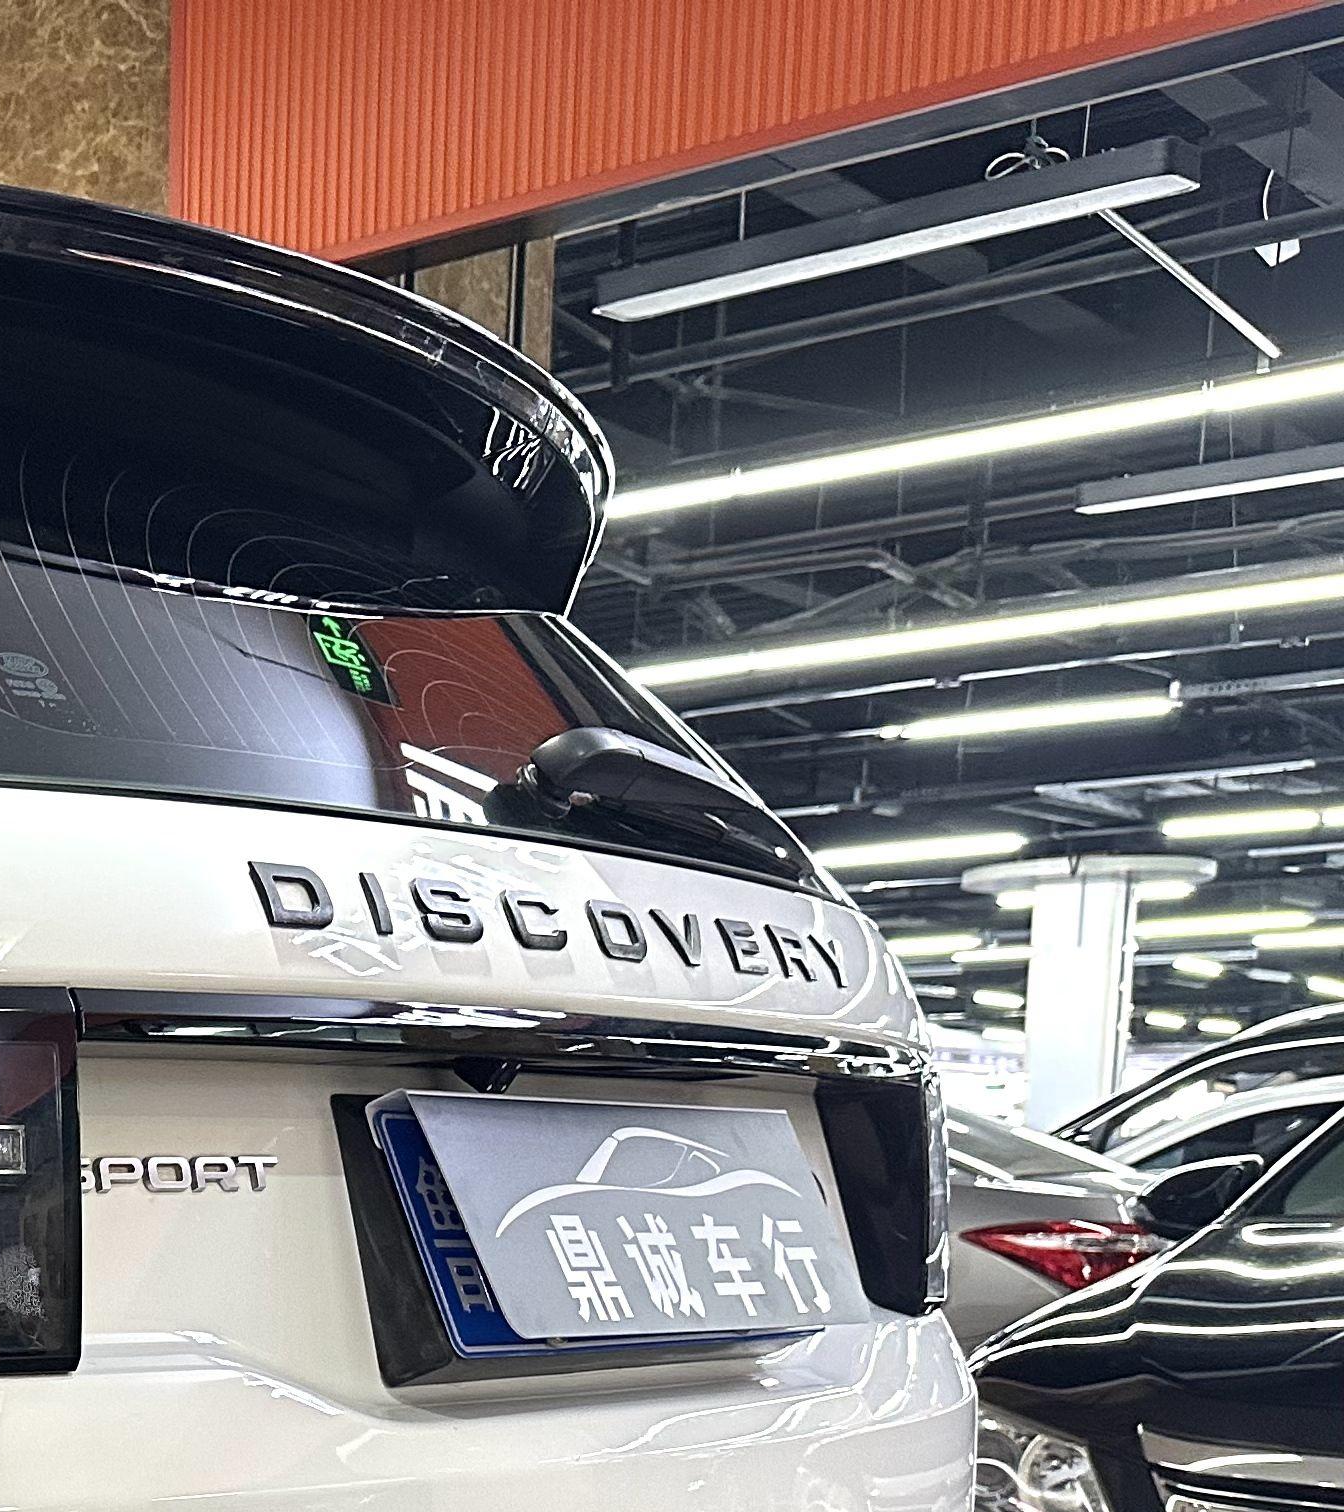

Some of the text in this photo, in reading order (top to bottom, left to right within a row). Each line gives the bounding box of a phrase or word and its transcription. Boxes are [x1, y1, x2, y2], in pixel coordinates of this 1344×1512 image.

[248, 860, 847, 988] DISCOVERY
[545, 1213, 832, 1323] 鼎诚车行
